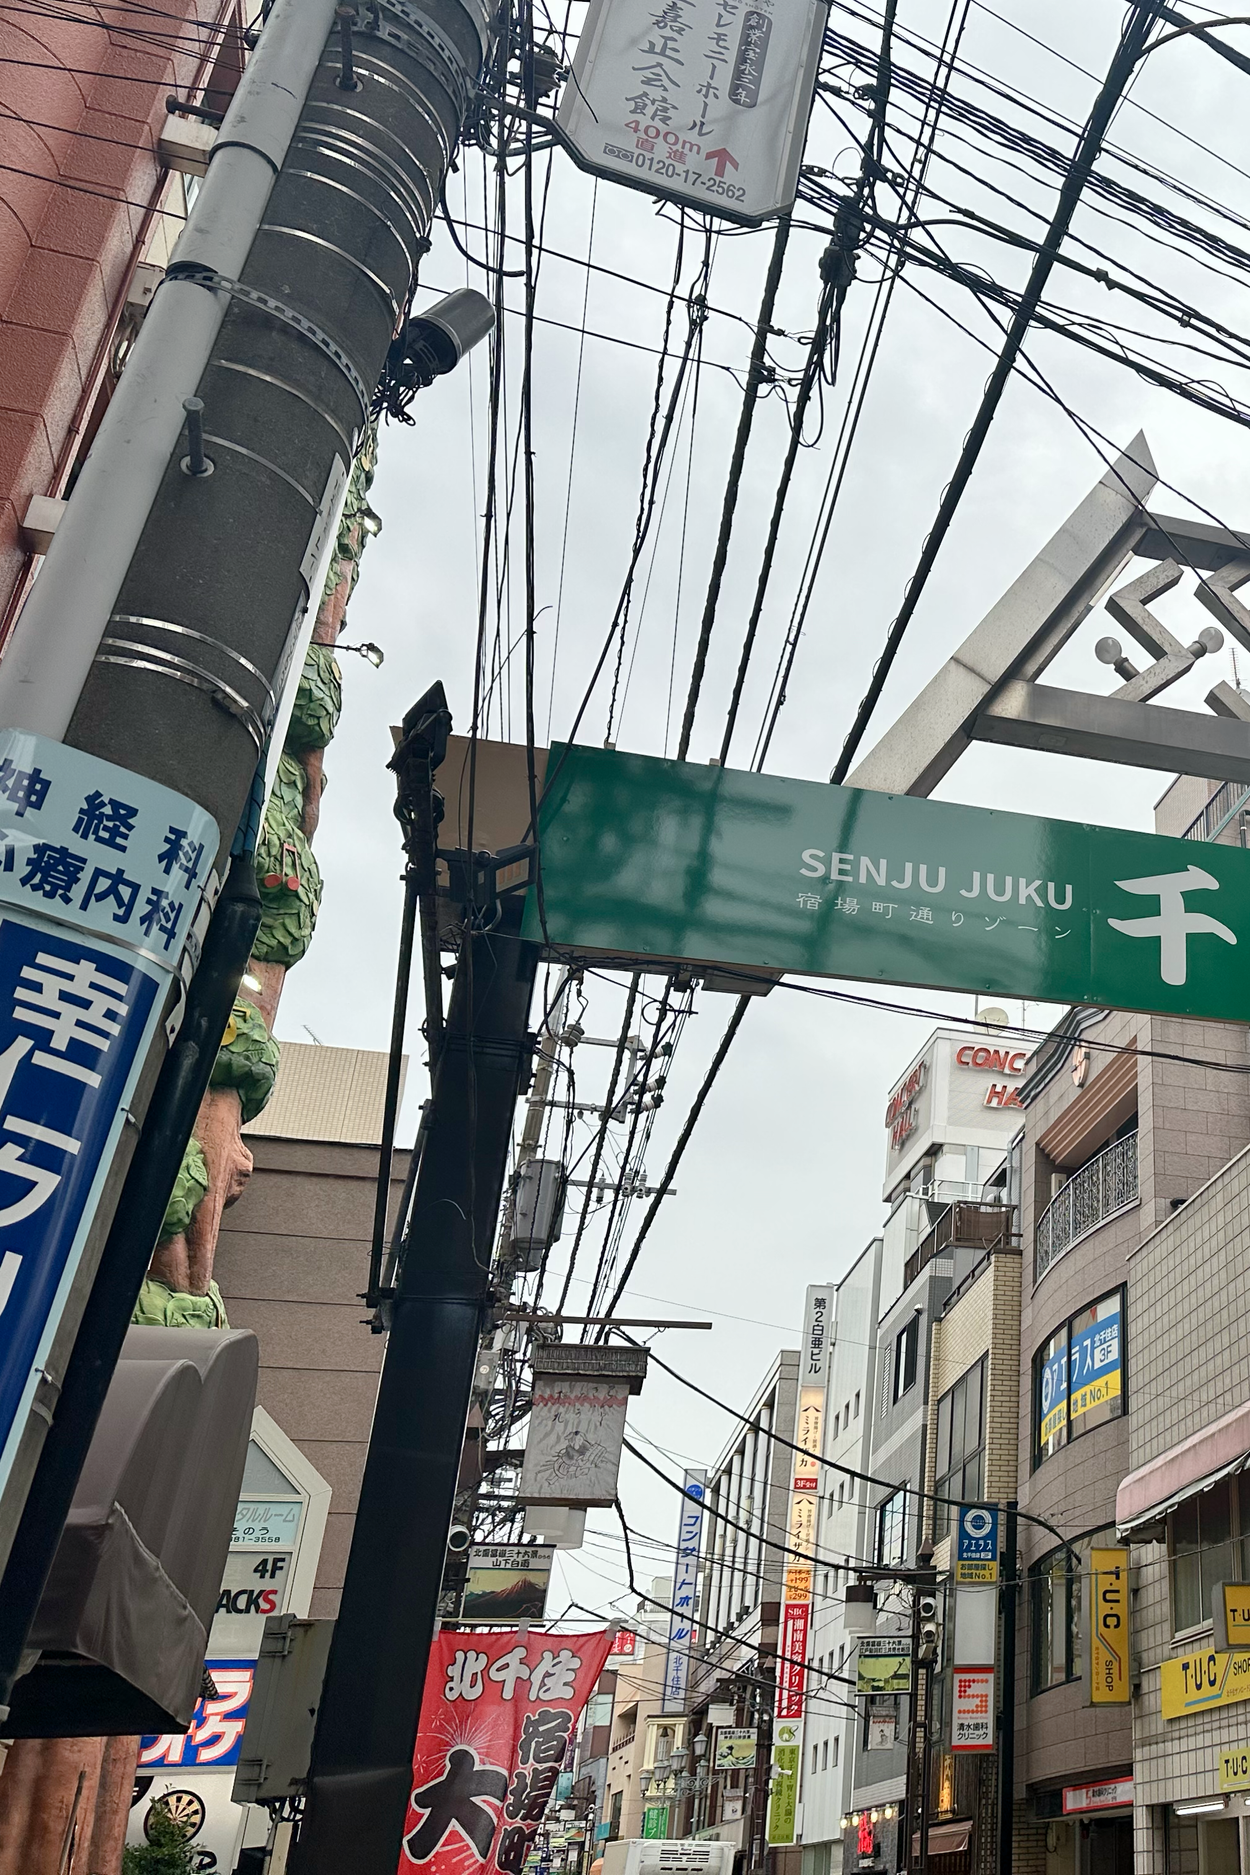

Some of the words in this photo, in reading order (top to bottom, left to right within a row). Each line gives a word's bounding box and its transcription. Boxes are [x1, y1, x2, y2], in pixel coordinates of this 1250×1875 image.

[624, 0, 697, 128] 嘉正会館
[686, 0, 739, 138] セレモニーホール
[731, 13, 768, 104] 創業宝永三年
[624, 118, 701, 156] 400m
[635, 136, 688, 166] 直進
[634, 151, 747, 204] 0120-17-2562
[798, 848, 947, 894] SENJU
[959, 870, 1074, 911] JUKU
[795, 892, 1072, 939] 宿場町通りゾーン
[890, 1106, 919, 1150] HALL
[808, 1297, 827, 1374] 第2白亜ビル
[1099, 1343, 1113, 1363] 3F
[1051, 1337, 1092, 1399] アエラス
[1094, 1323, 1119, 1348] 北千住店
[492, 1558, 531, 1568] 山下白雨
[960, 1563, 994, 1571] お部屋探し
[962, 1540, 993, 1551] アエラス
[252, 1557, 286, 1580] 4F
[672, 1515, 701, 1642] コンサートホール
[960, 1572, 993, 1580] 地域No.1
[215, 1588, 279, 1615] ACKS
[788, 1607, 806, 1616] SBC
[445, 1645, 582, 1701] 北千住
[669, 1654, 683, 1697] 北千住店
[787, 1618, 805, 1716] 湘南美容クリニック
[1104, 1659, 1114, 1692] SHOP
[194, 1669, 254, 1716] ラ
[956, 1721, 989, 1732] 清水歯科
[956, 1731, 989, 1741] クリニック
[402, 1744, 510, 1864] 大
